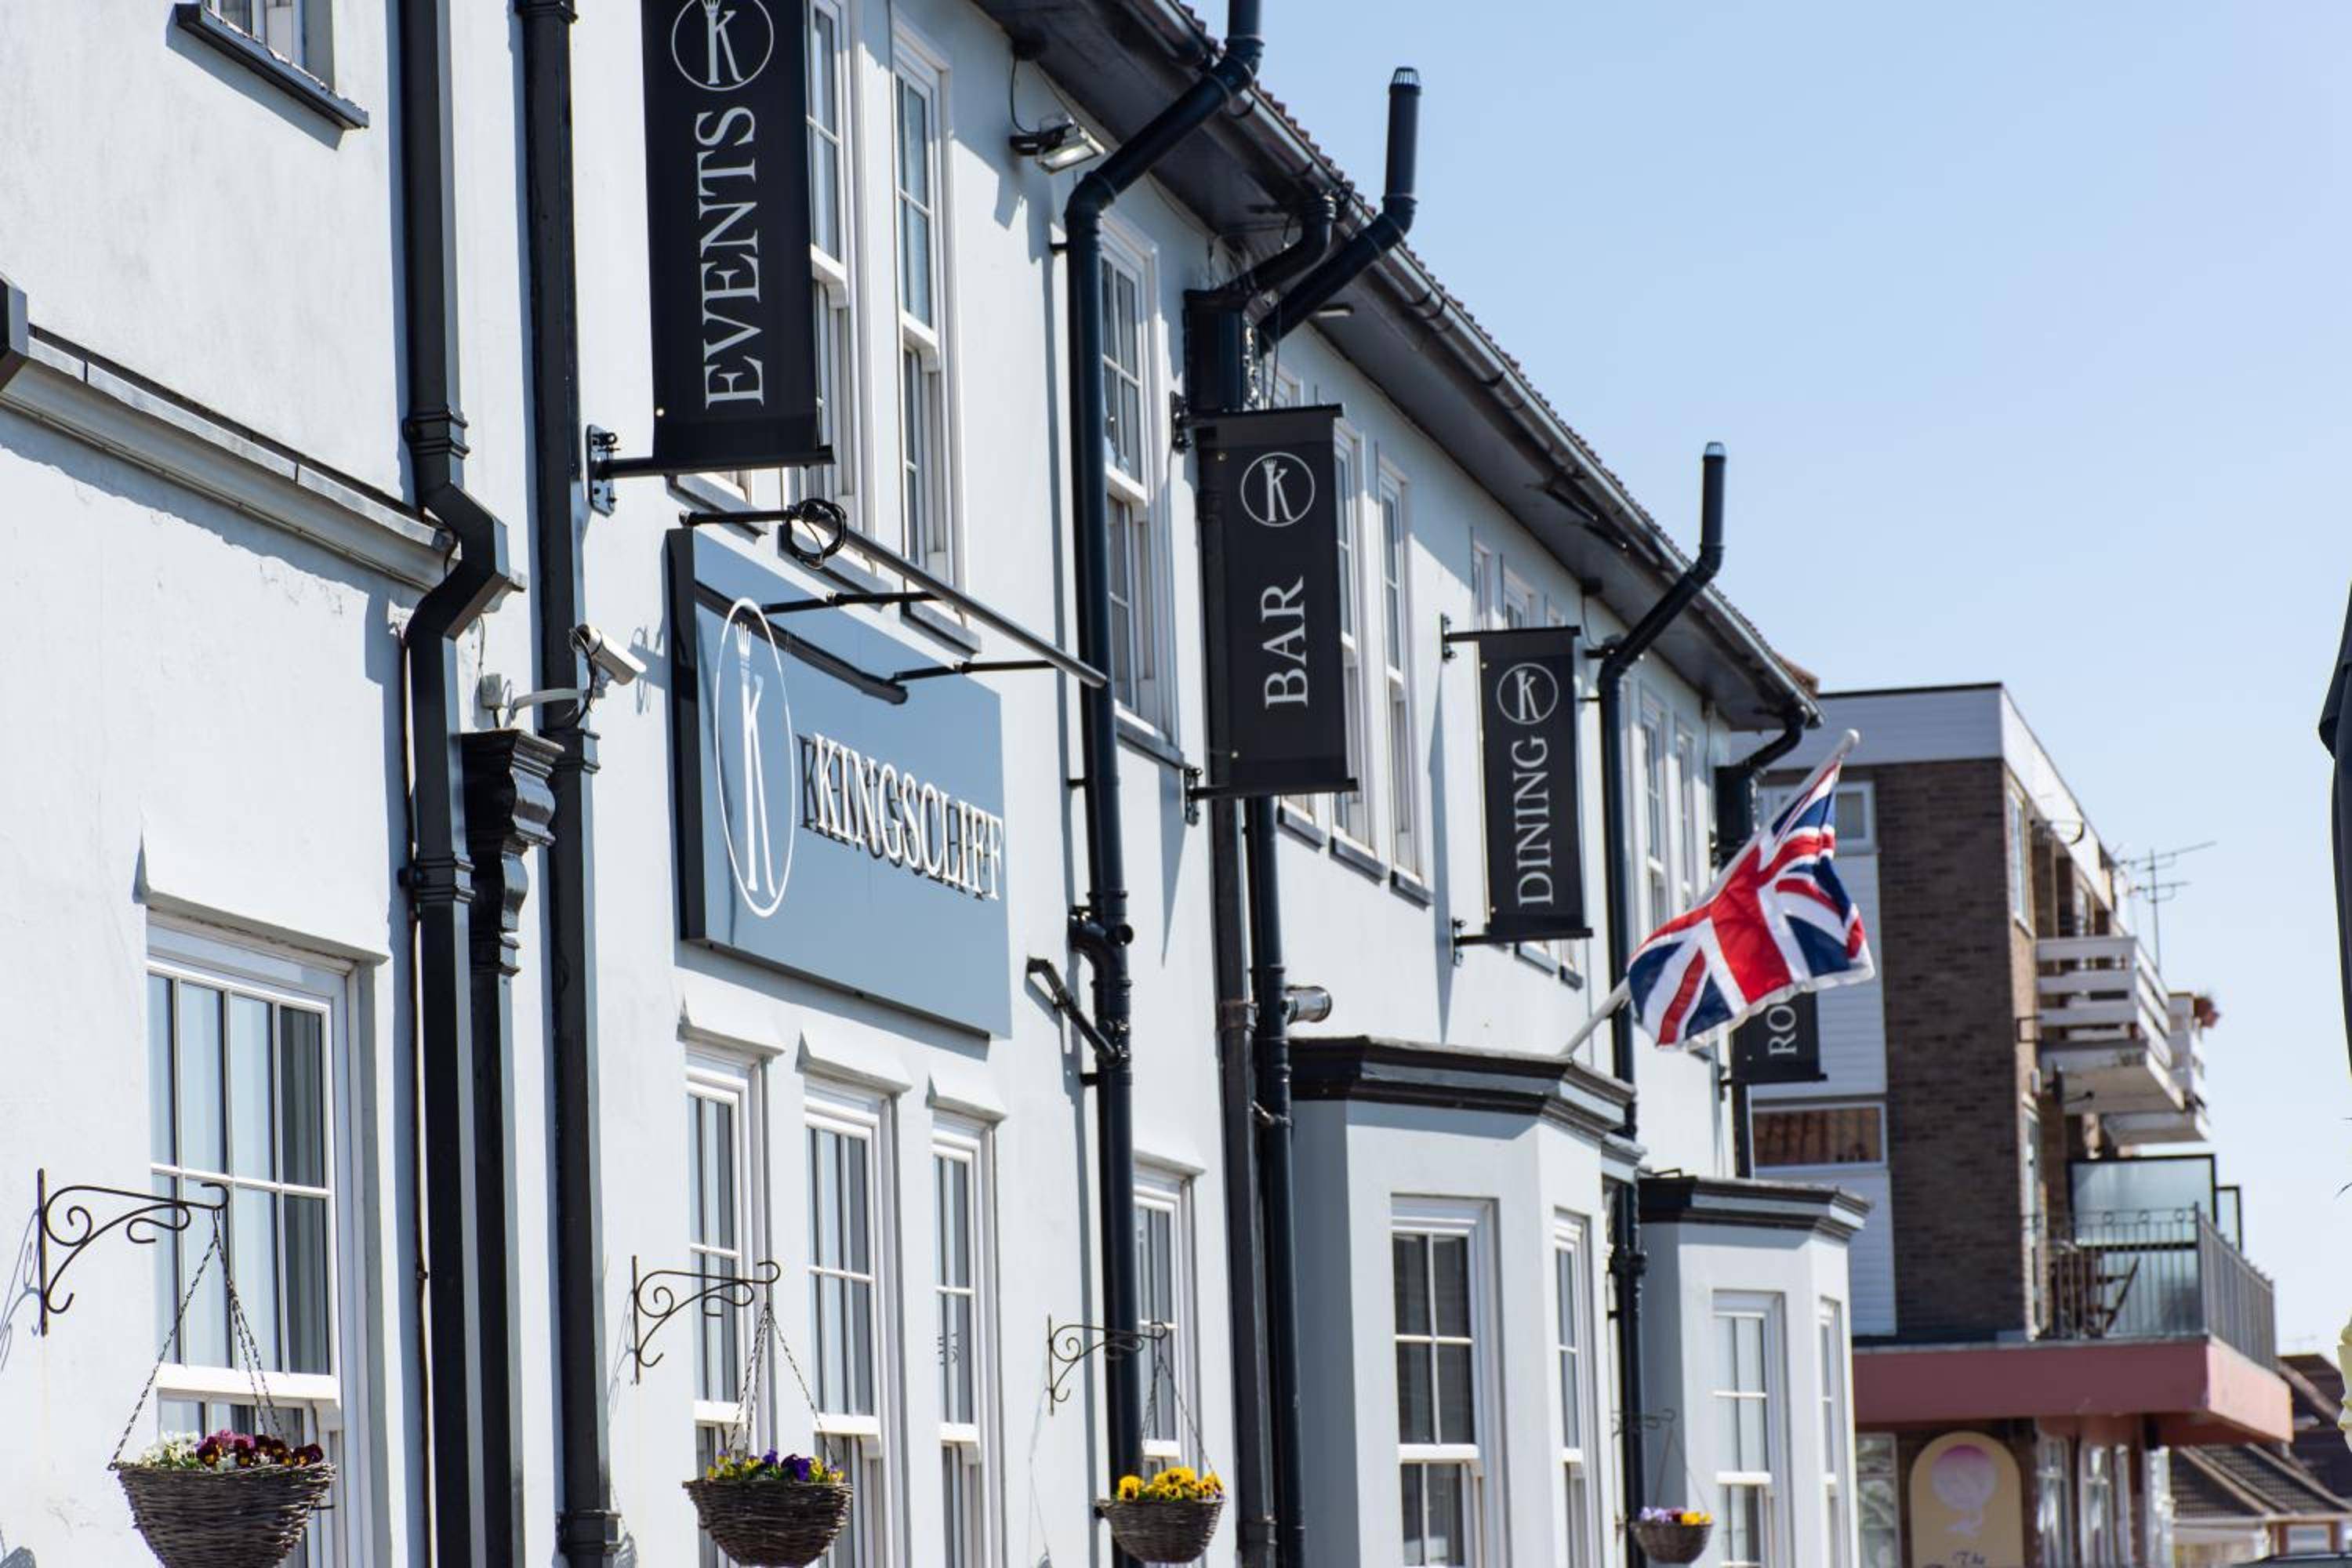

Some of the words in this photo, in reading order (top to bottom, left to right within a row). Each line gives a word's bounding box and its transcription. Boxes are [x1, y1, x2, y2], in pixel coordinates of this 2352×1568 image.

[695, 107, 764, 409] EVENTS
[1261, 576, 1308, 709] BAR
[814, 732, 1003, 900] KINGSCLIFF
[1512, 735, 1554, 906] DINING
[1766, 1005, 1798, 1054] RO
